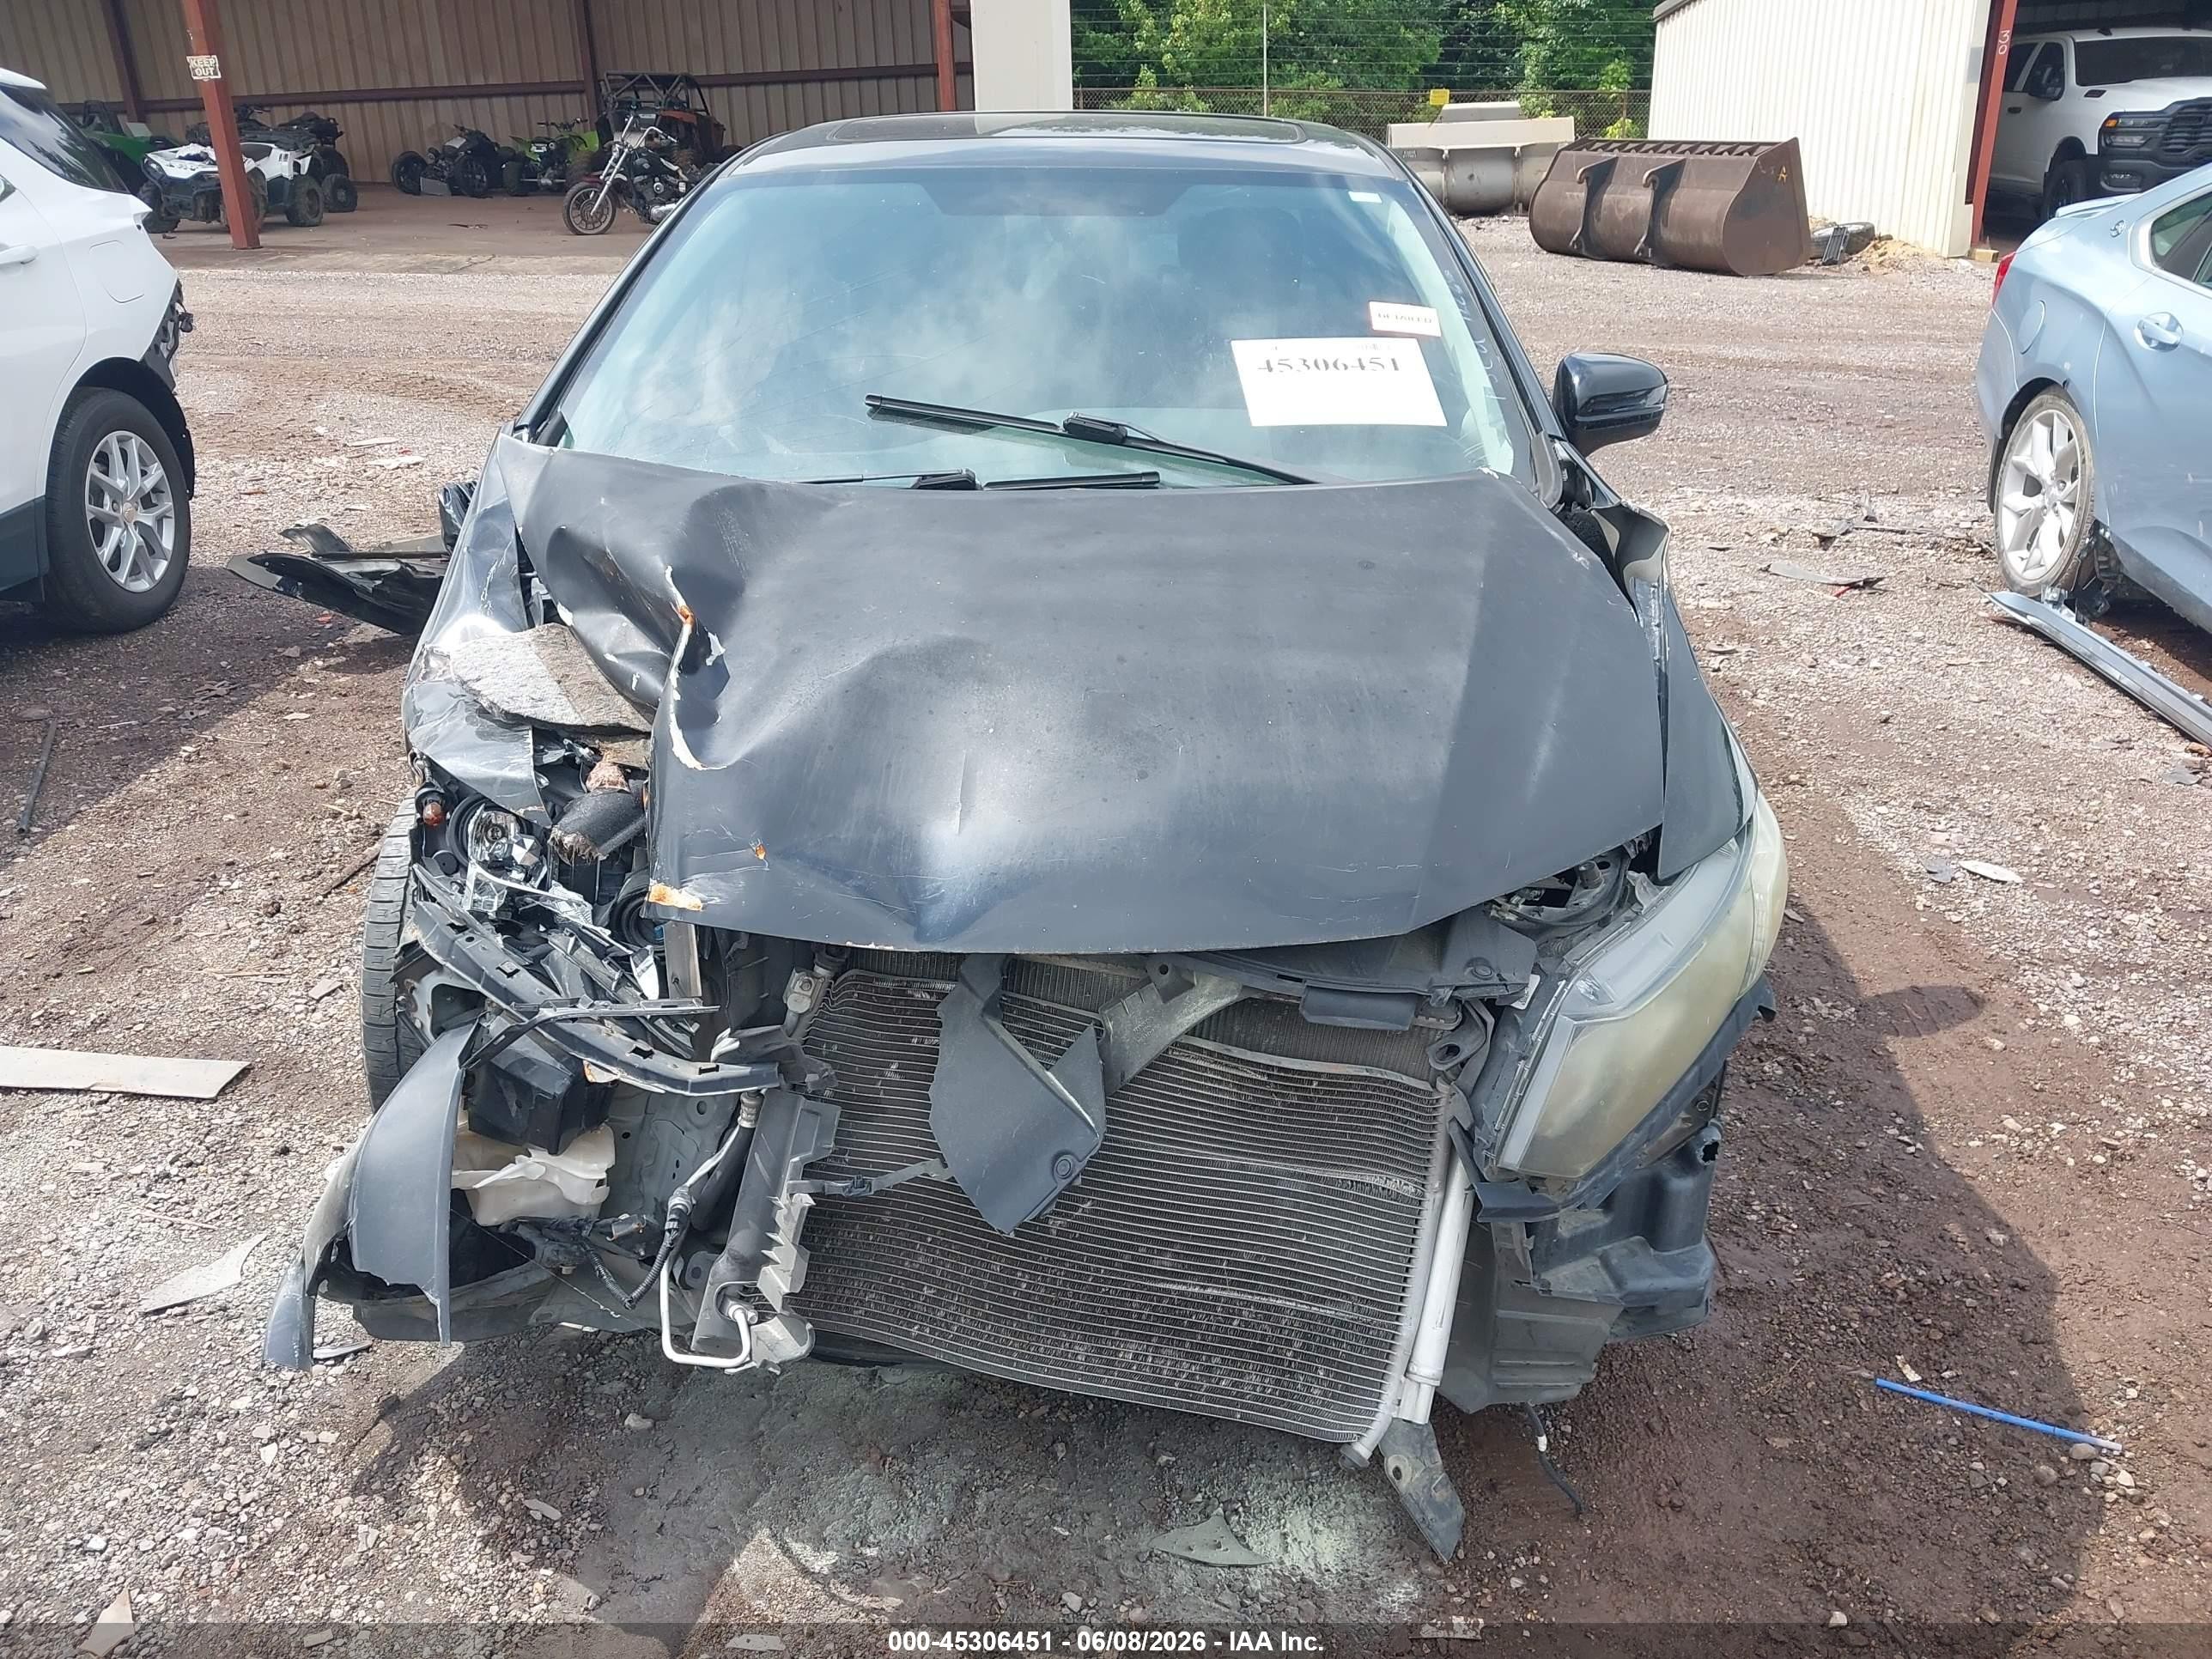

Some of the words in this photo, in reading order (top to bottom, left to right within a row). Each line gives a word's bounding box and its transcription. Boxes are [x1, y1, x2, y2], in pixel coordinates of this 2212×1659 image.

[190, 58, 216, 69] KEEP
[194, 68, 214, 76] OUT
[1257, 356, 1401, 373] 45306451
